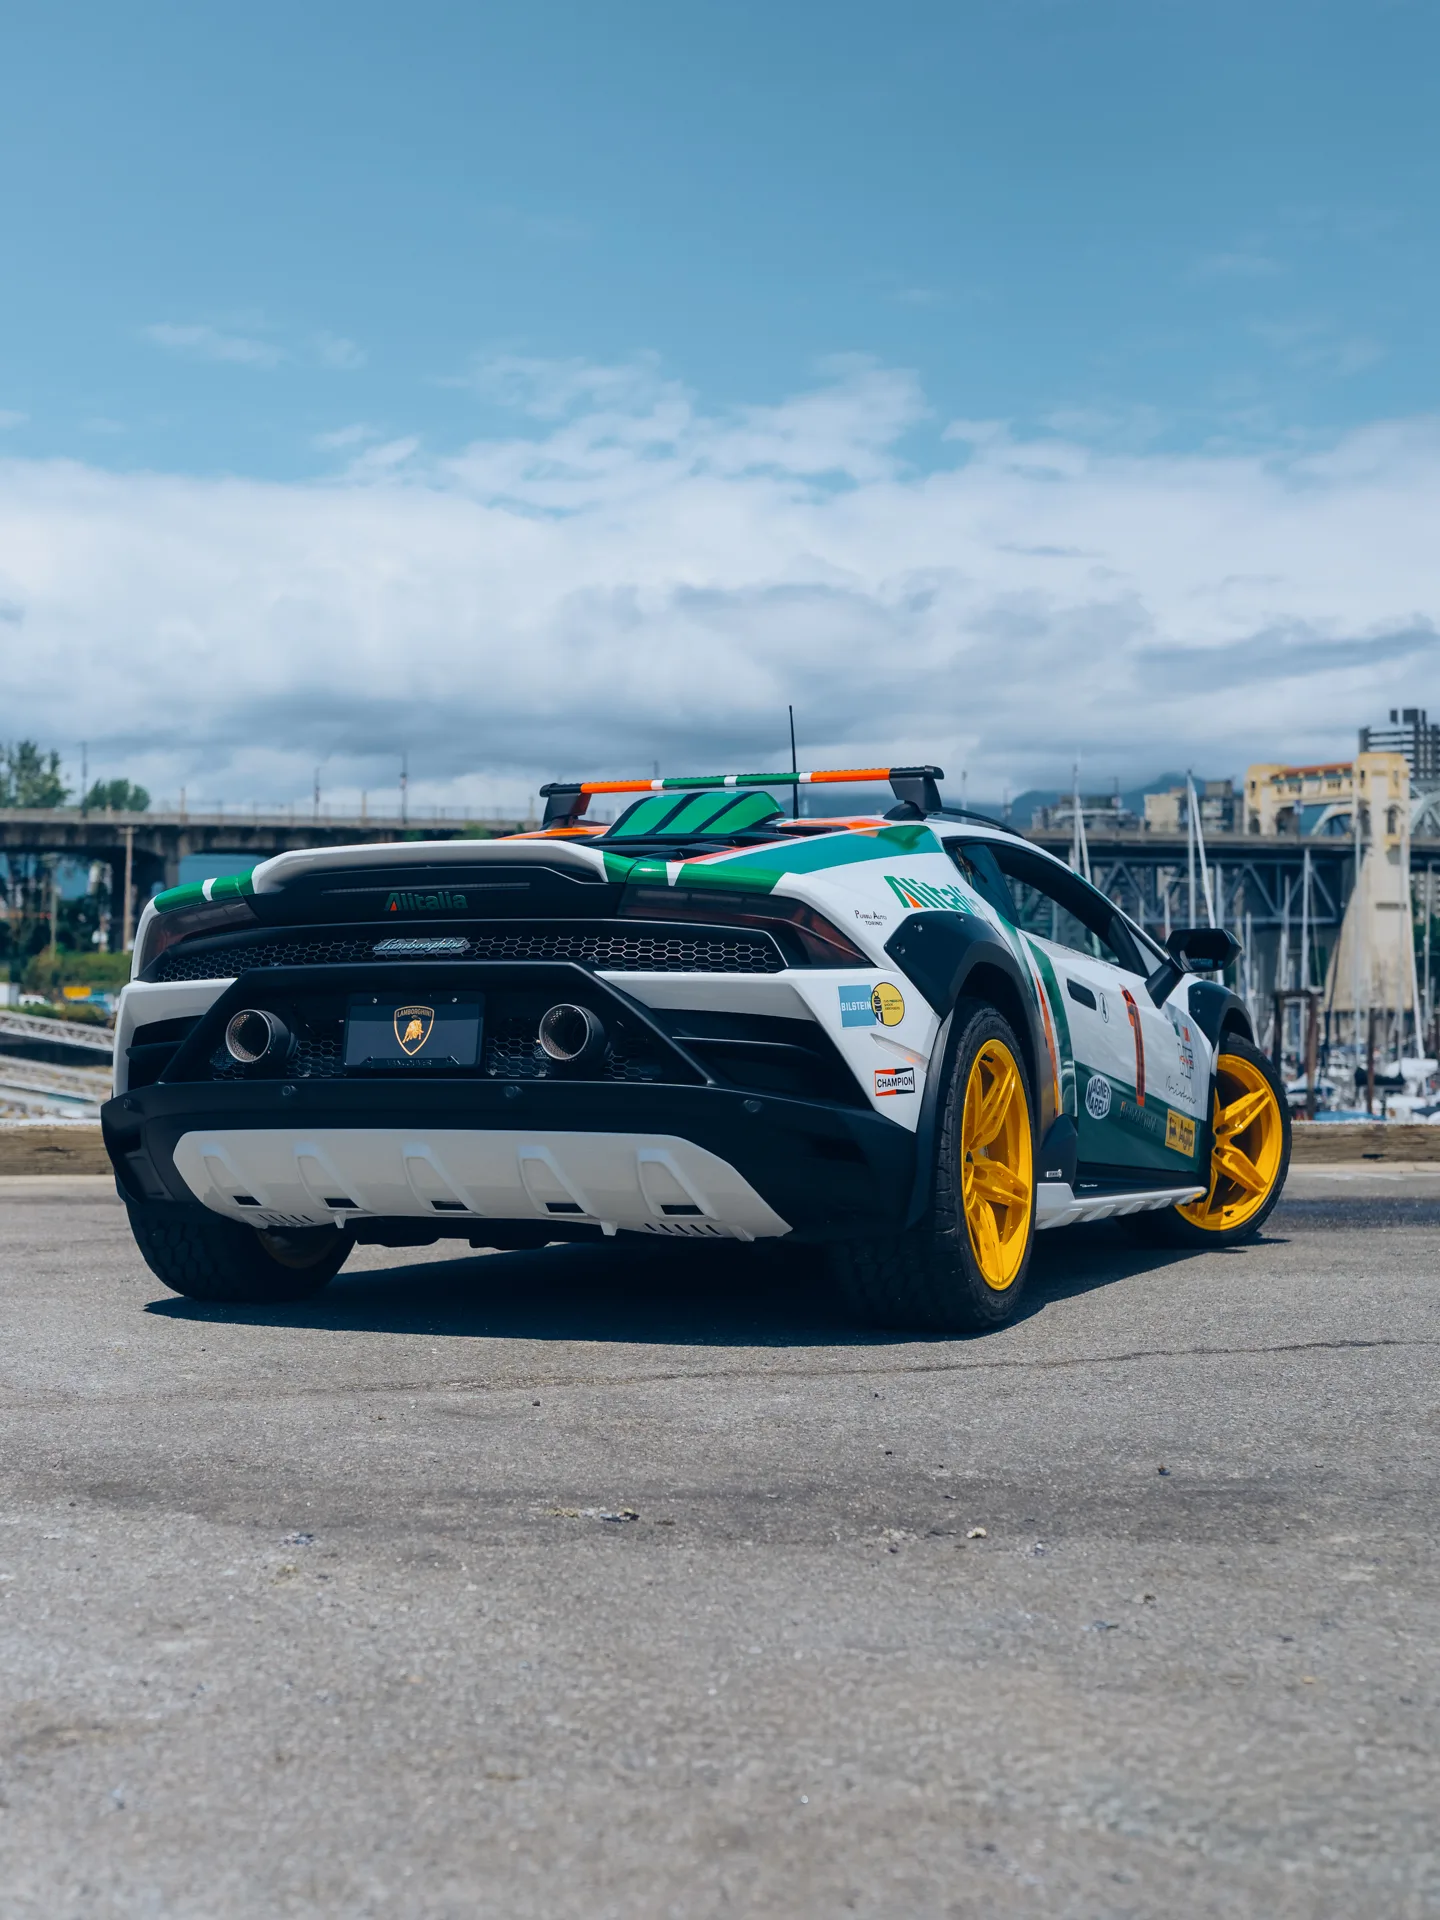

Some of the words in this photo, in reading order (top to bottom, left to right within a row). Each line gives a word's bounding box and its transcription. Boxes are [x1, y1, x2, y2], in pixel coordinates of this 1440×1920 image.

[384, 892, 468, 911] Alitalia
[373, 938, 466, 952] Lamborghini
[841, 1001, 872, 1012] BILSTEIN
[397, 1008, 432, 1018] LAMBORGHINI
[877, 1076, 913, 1088] CHAMPION
